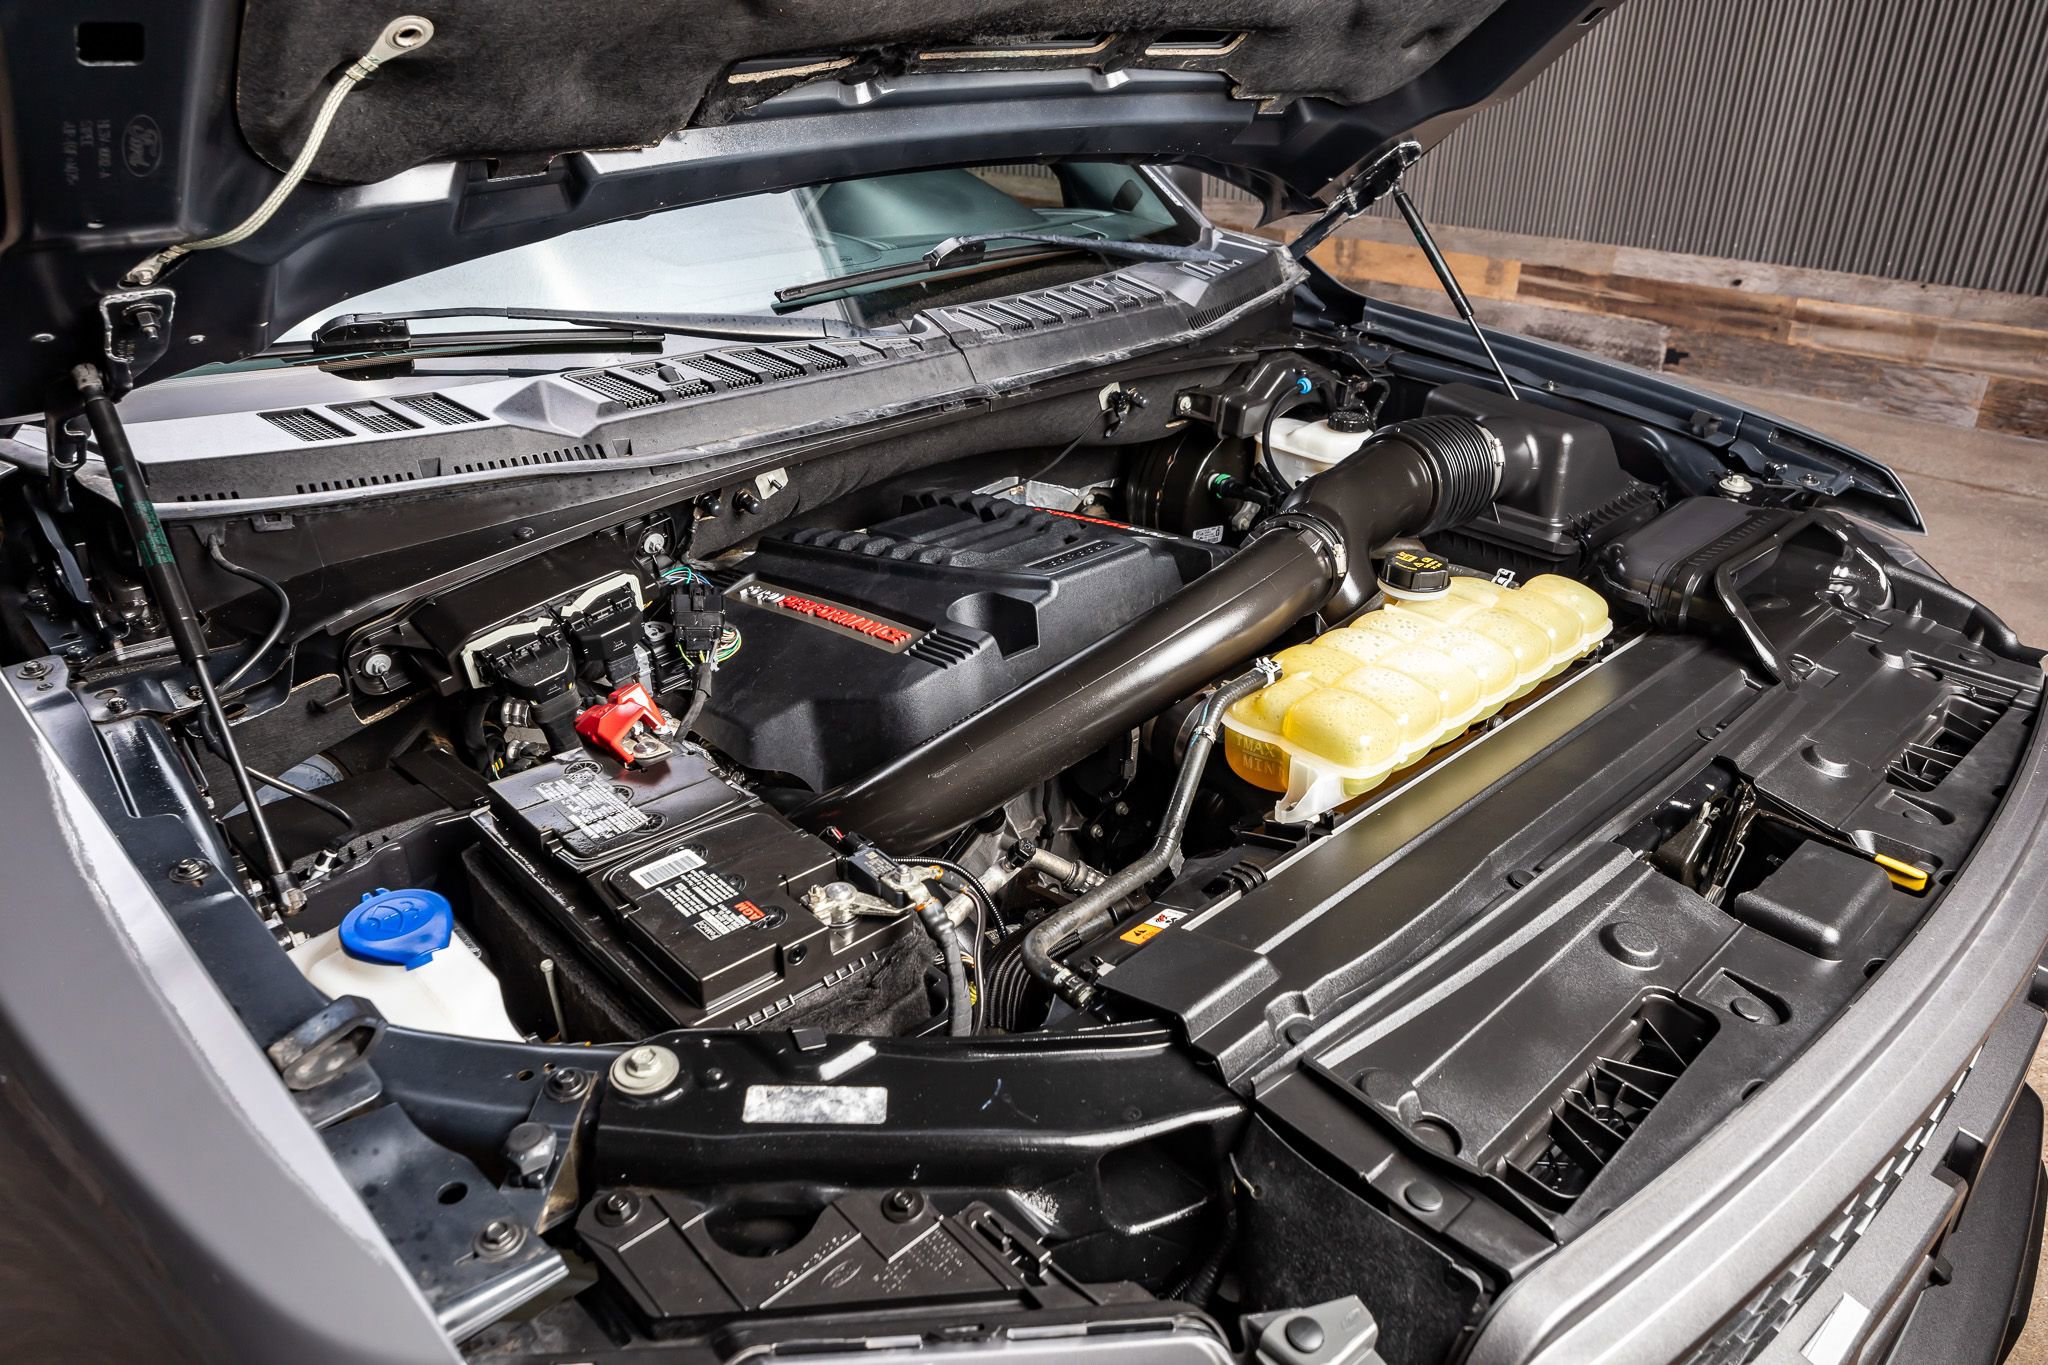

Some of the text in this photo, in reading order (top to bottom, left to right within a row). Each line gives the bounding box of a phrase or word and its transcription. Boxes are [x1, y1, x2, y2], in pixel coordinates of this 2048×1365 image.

[776, 596, 912, 646] PERFORMANCE
[1243, 736, 1275, 758] MAX
[1242, 754, 1275, 776] MIN
[734, 901, 762, 921] AGM
